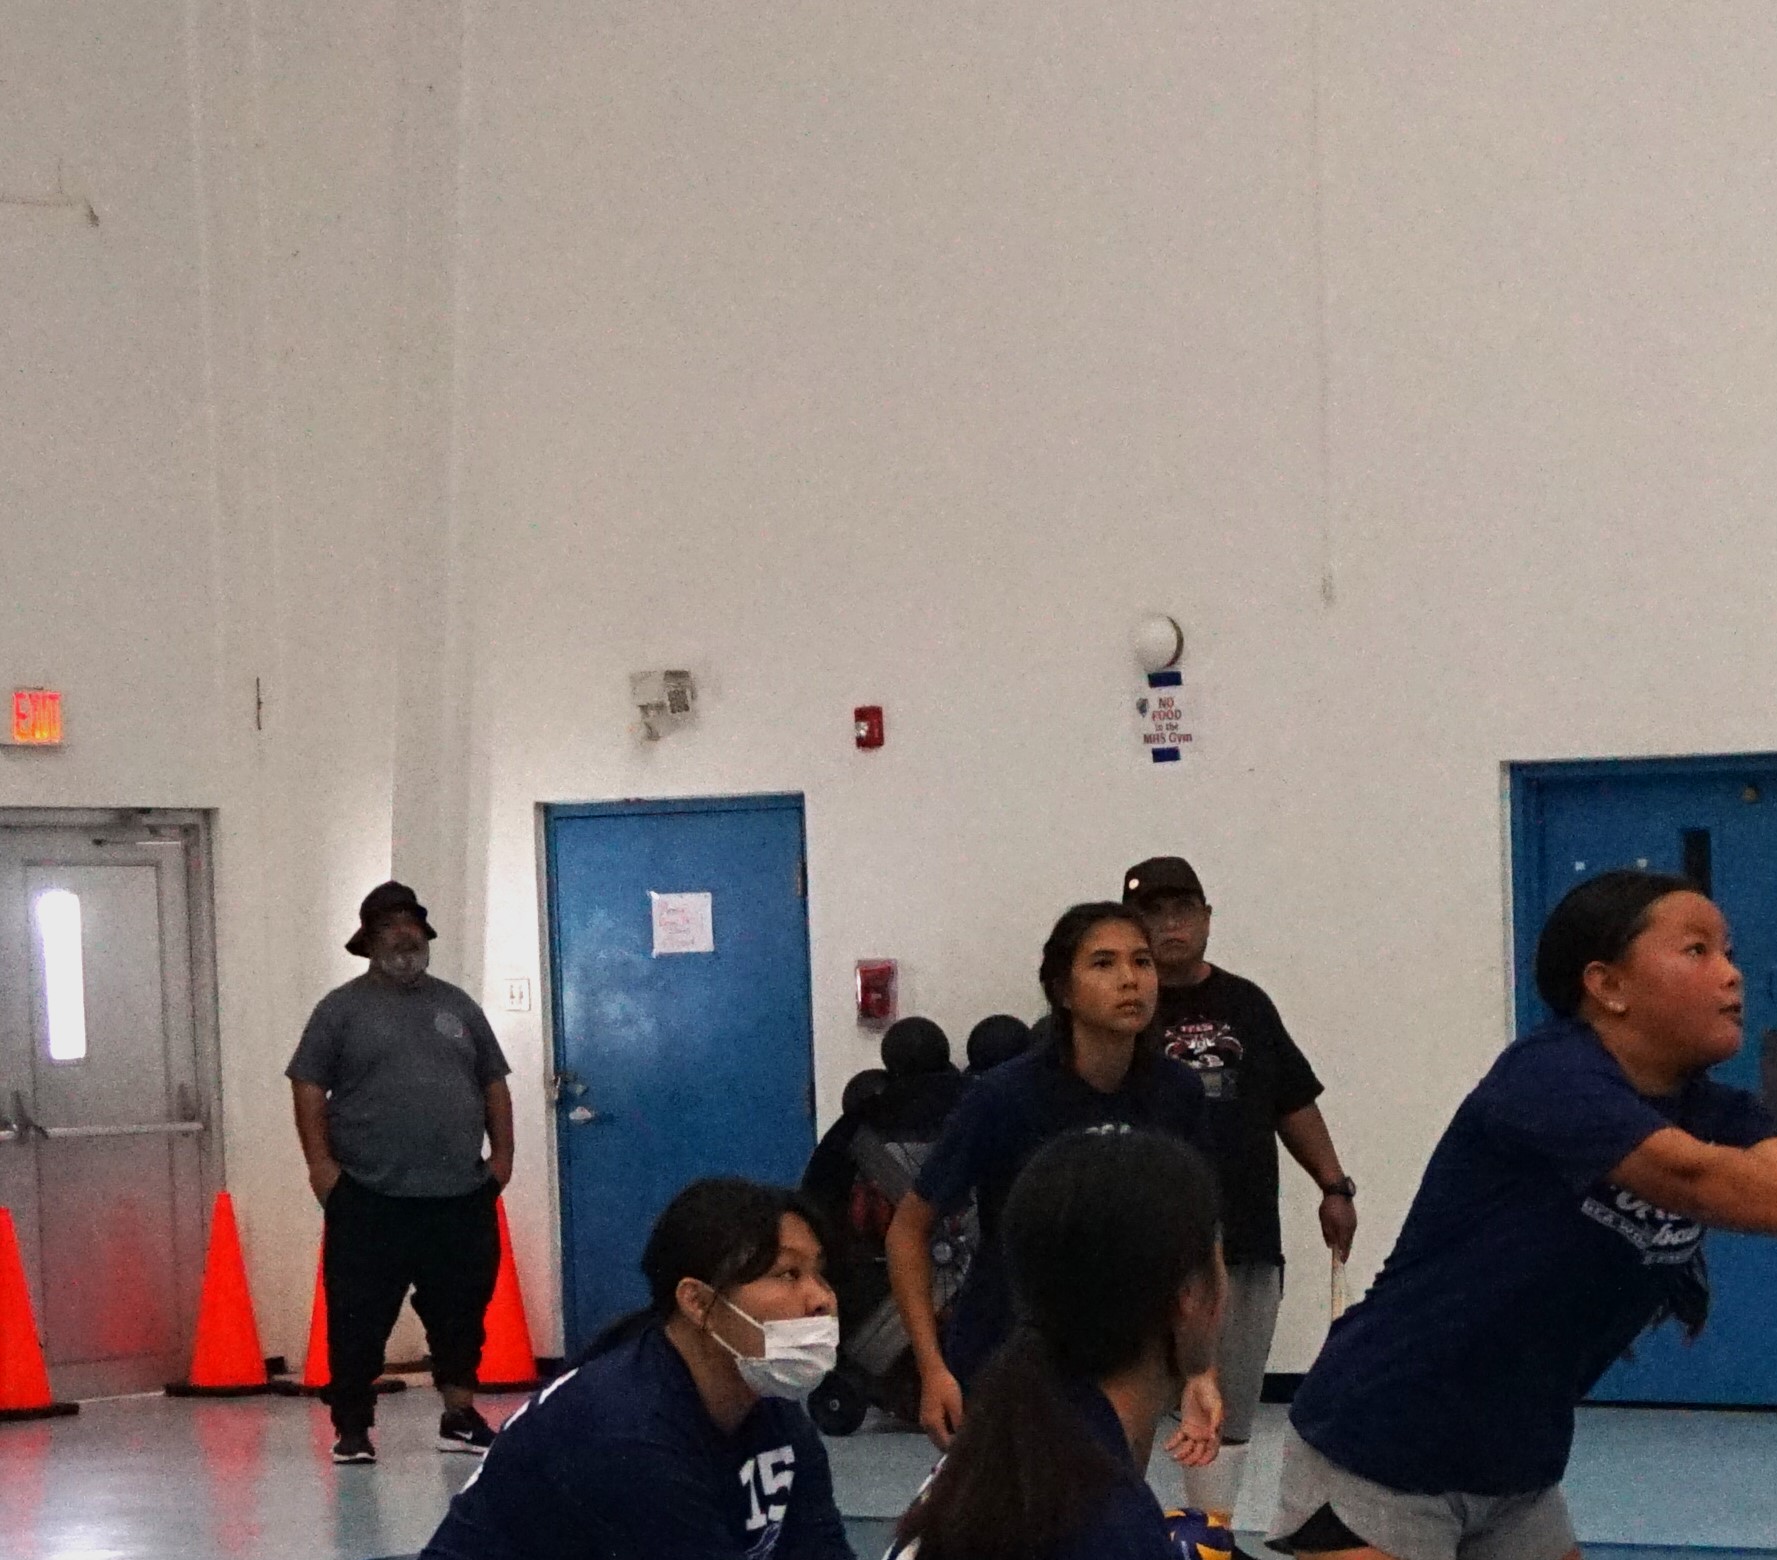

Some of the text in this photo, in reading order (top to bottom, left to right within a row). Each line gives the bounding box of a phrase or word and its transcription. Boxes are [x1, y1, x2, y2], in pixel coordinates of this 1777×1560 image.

[1158, 697, 1175, 709] NO
[14, 692, 62, 742] EXIT
[1152, 709, 1182, 721] FOOD
[1143, 732, 1193, 744] MHS Gym
[739, 1444, 796, 1531] 15
